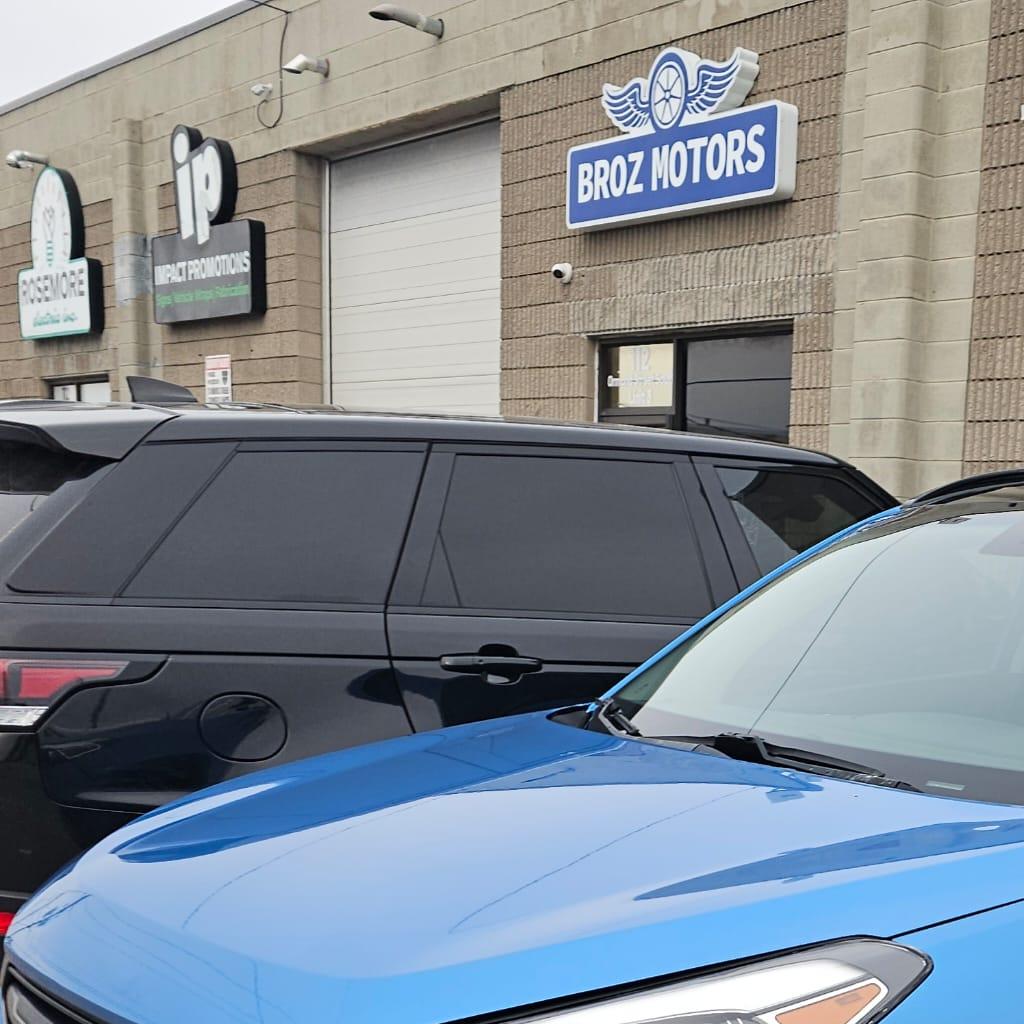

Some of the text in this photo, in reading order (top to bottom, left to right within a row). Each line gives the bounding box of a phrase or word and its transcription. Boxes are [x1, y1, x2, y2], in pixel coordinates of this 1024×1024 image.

[577, 124, 766, 203] BROZ MOTORS
[22, 267, 85, 305] ROSEMORE
[154, 250, 250, 286] IMPACT PROMOTIONS
